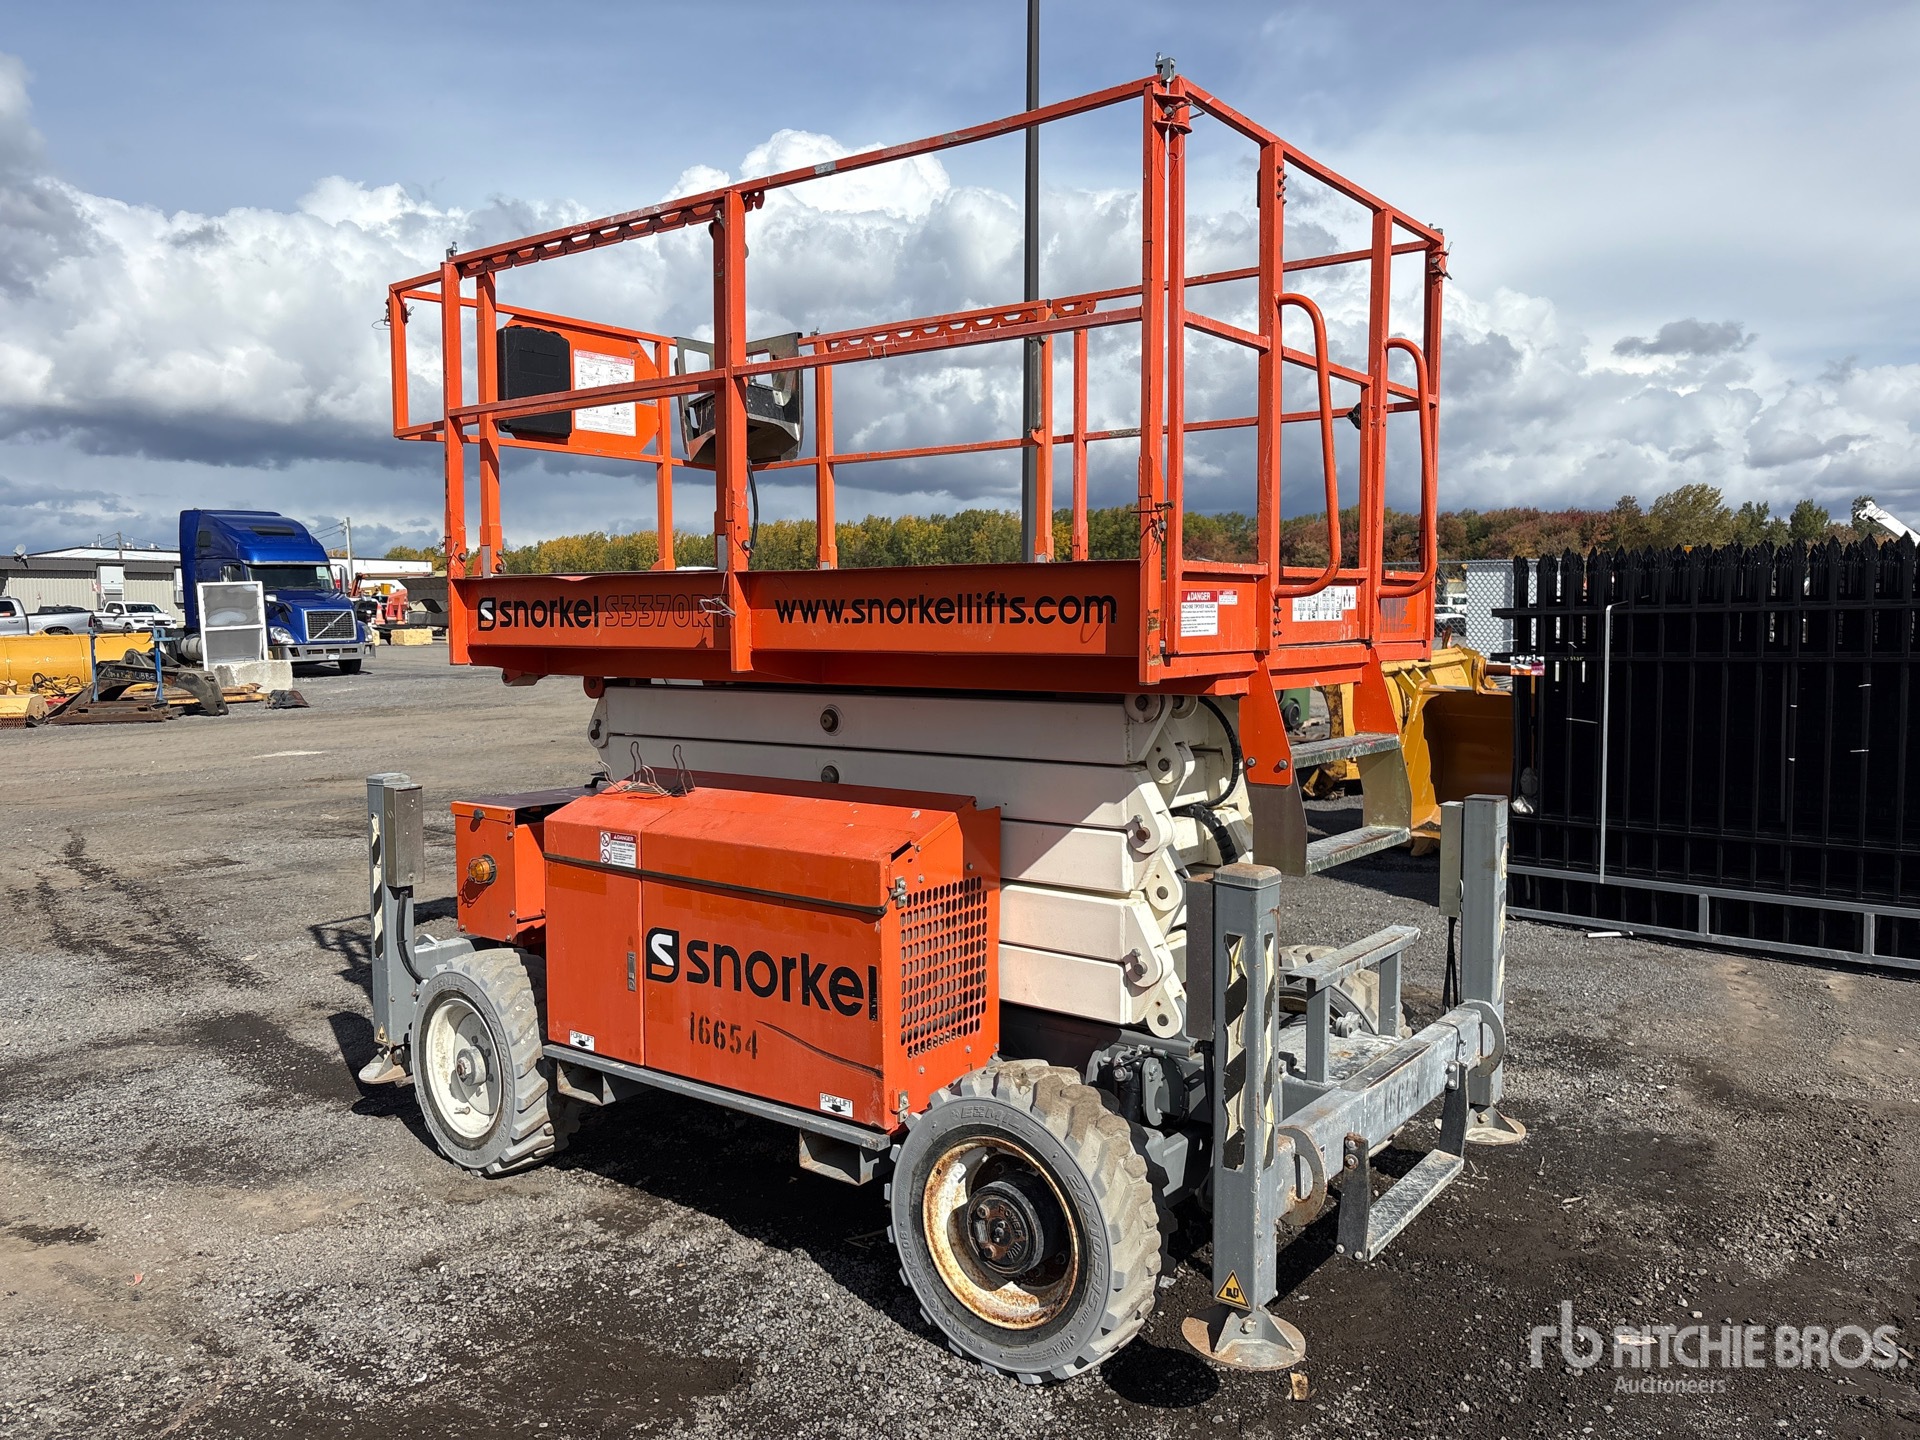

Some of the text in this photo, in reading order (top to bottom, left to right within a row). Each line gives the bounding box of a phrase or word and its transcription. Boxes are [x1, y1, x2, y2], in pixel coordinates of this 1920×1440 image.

[499, 596, 599, 628] snorkel
[774, 591, 1117, 625] www.snorkellifts.com
[1190, 592, 1211, 601] DANGER
[686, 939, 879, 1022] snorkel
[689, 1011, 759, 1060] 16654
[821, 1094, 838, 1105] FORK
